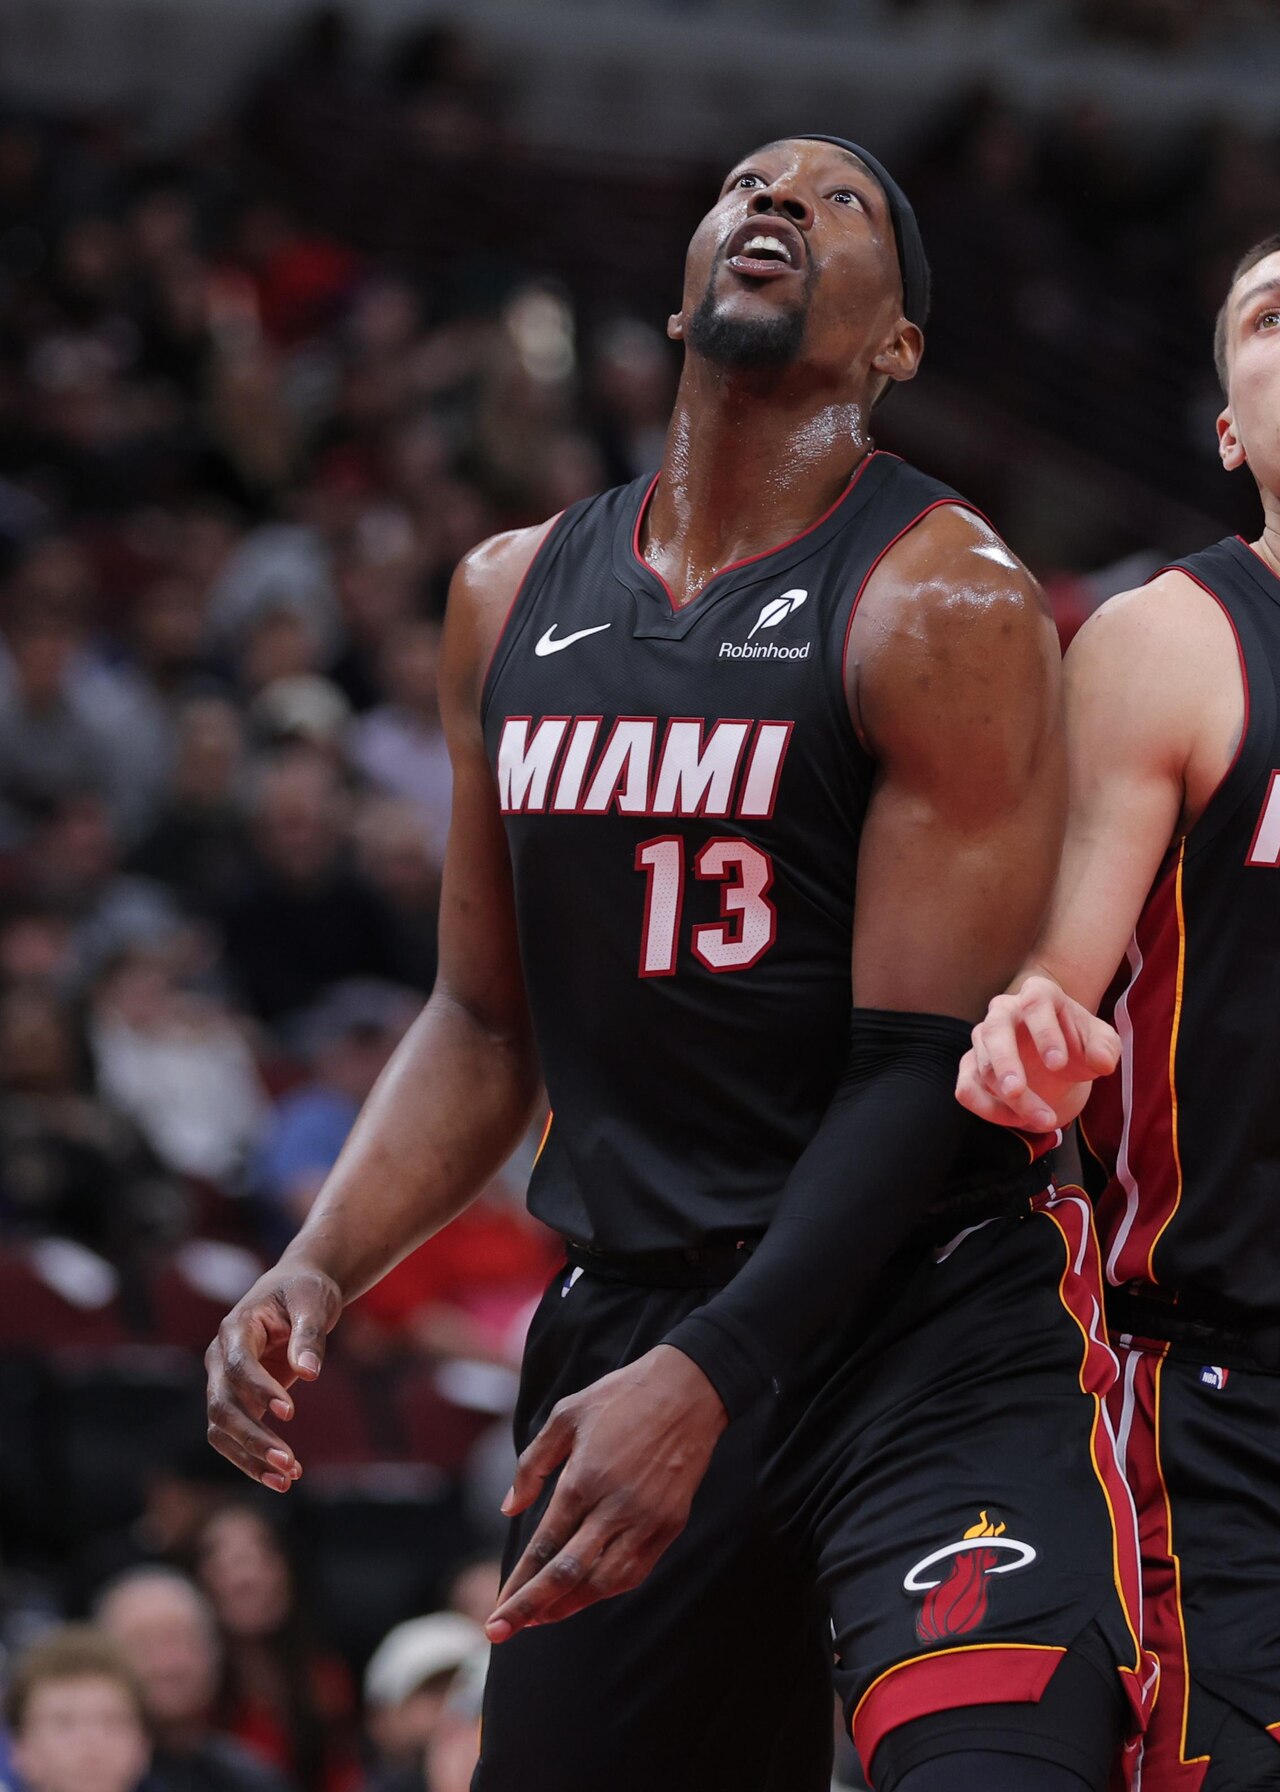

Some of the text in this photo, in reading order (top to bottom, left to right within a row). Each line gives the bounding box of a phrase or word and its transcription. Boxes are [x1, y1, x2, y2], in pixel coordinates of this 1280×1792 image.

[718, 642, 811, 659] Robinhood
[498, 715, 795, 820] MIAMI
[634, 834, 777, 978] 13
[1202, 1371, 1218, 1385] NBA
